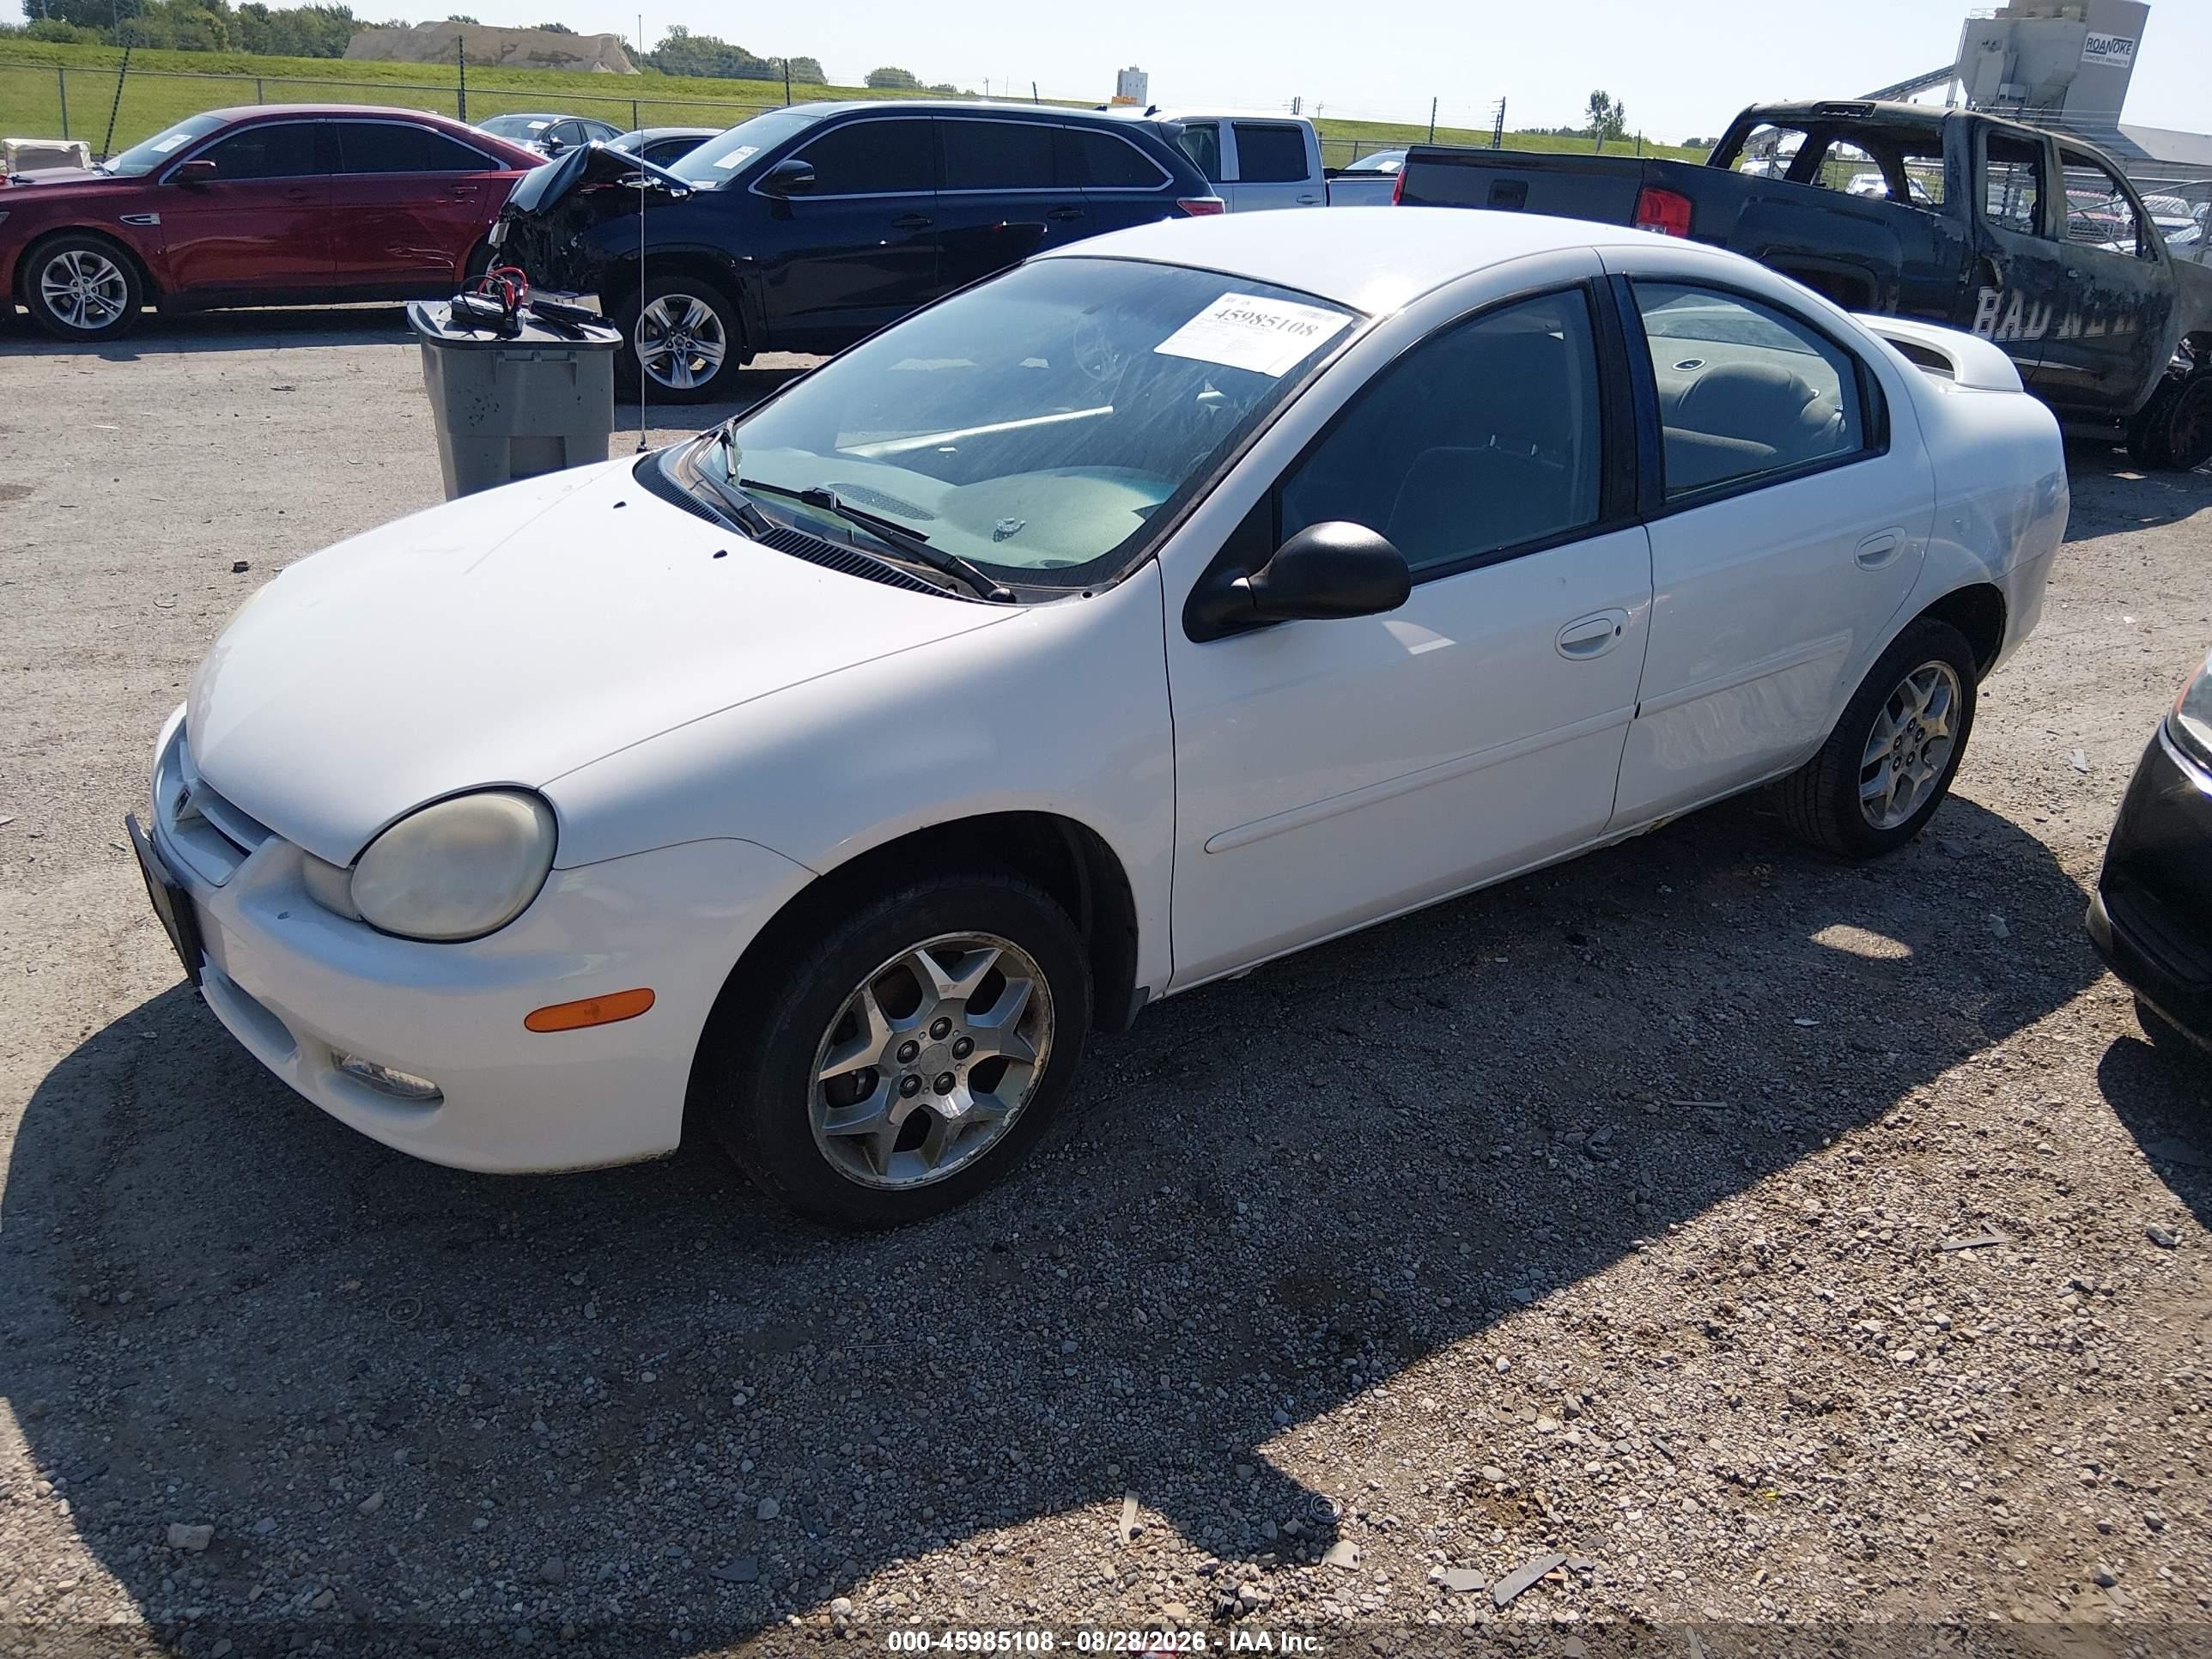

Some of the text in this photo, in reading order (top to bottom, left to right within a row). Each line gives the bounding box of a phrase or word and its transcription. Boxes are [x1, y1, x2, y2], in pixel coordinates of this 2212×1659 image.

[2086, 38, 2133, 55] ROANOKE
[1213, 308, 1319, 337] 45985108
[1970, 286, 2052, 342] BAD
